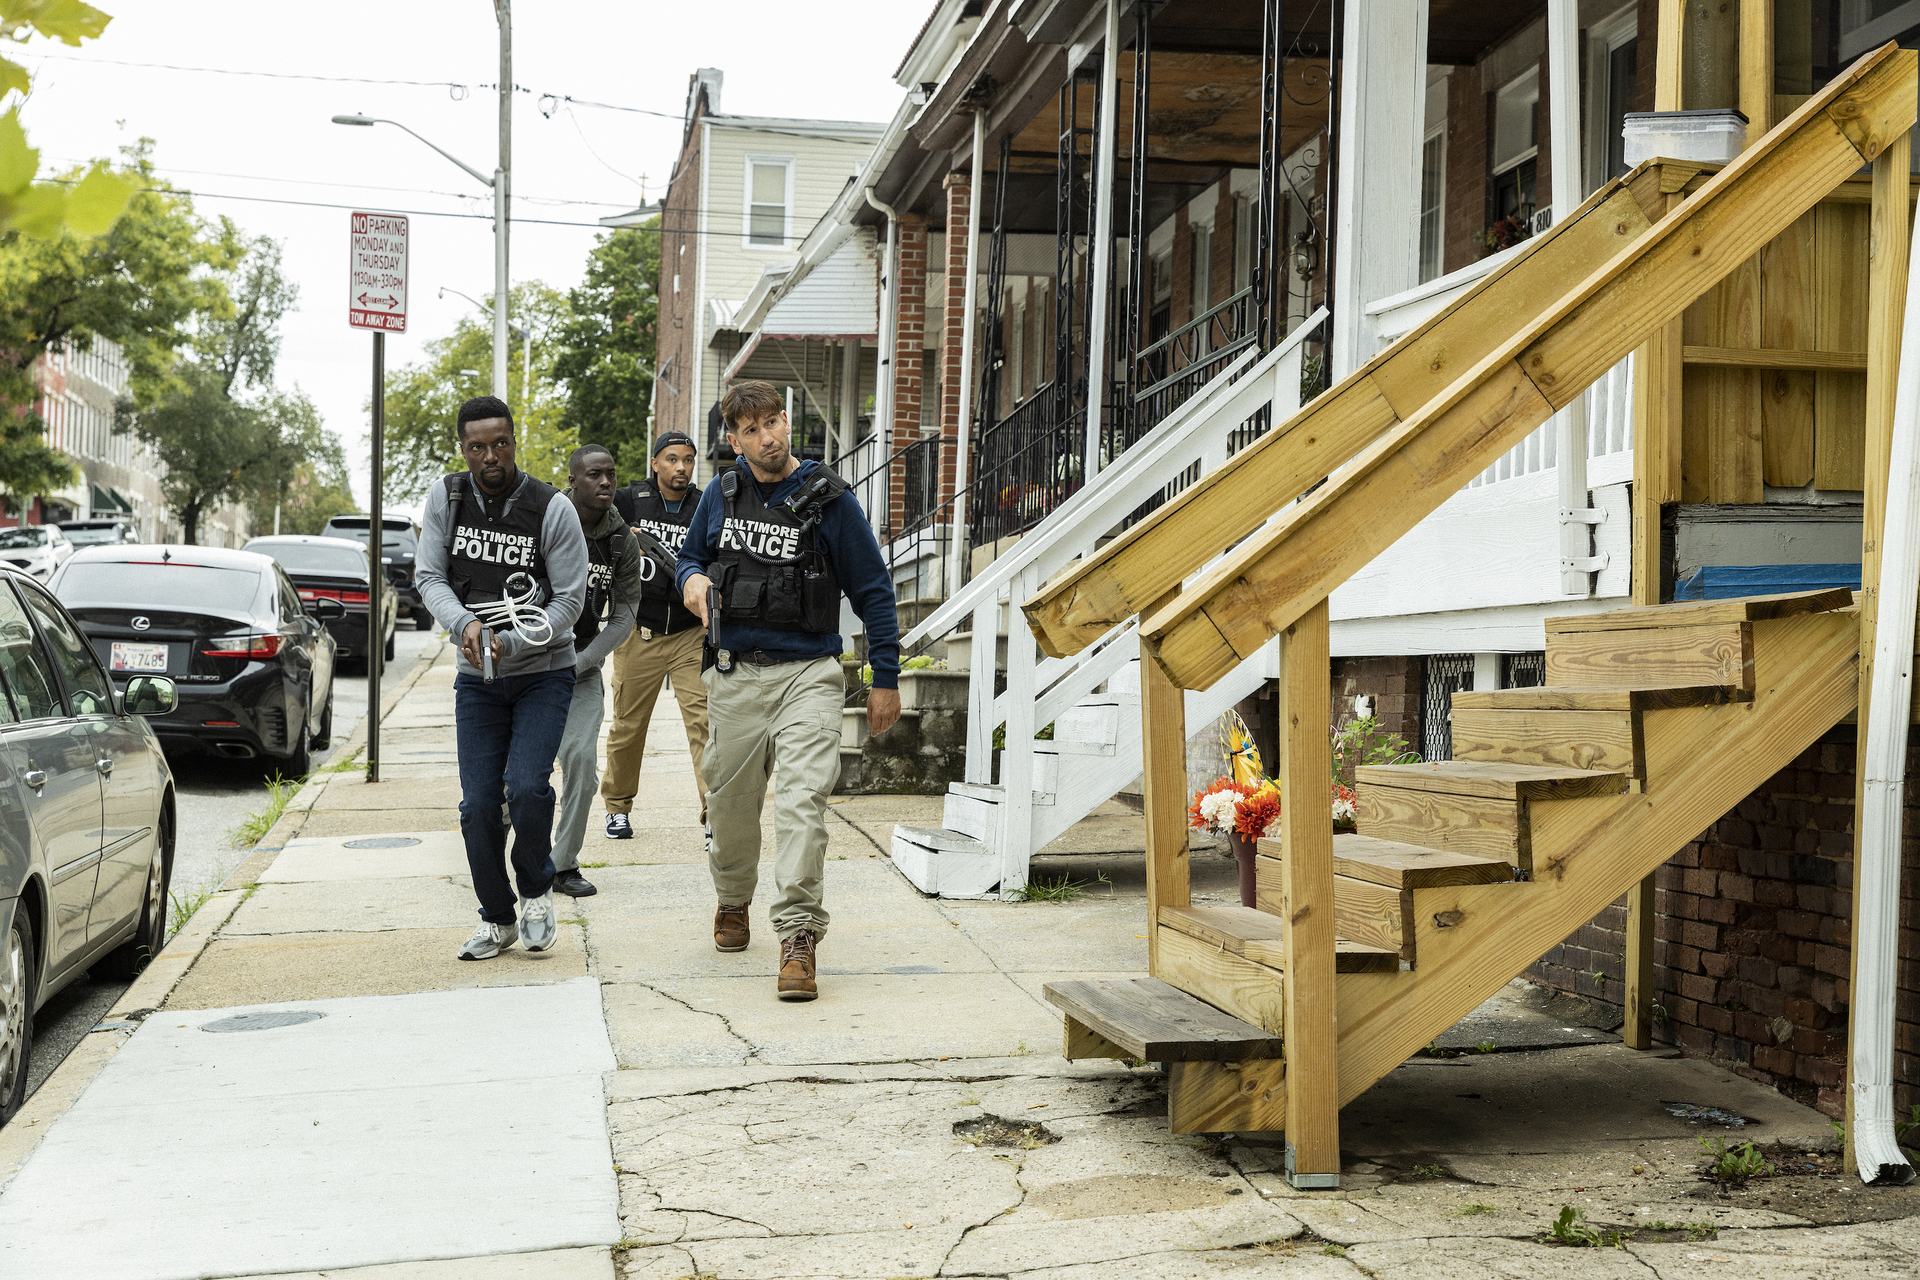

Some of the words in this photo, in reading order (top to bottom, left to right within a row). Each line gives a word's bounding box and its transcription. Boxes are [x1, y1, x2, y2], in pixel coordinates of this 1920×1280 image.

[353, 215, 367, 233] NO
[369, 218, 405, 237] PARKING
[1536, 208, 1551, 233] 810
[355, 236, 389, 252] MONDAY
[389, 242, 404, 254] AND
[358, 253, 400, 271] THURSDAY
[351, 311, 365, 325] TOW
[365, 313, 385, 327] AWAY
[385, 315, 405, 330] ZONE
[456, 525, 536, 548] BALTIMORE
[723, 518, 800, 540] BALTIMORE
[452, 536, 535, 568] POLICE
[719, 528, 798, 559] POLICE
